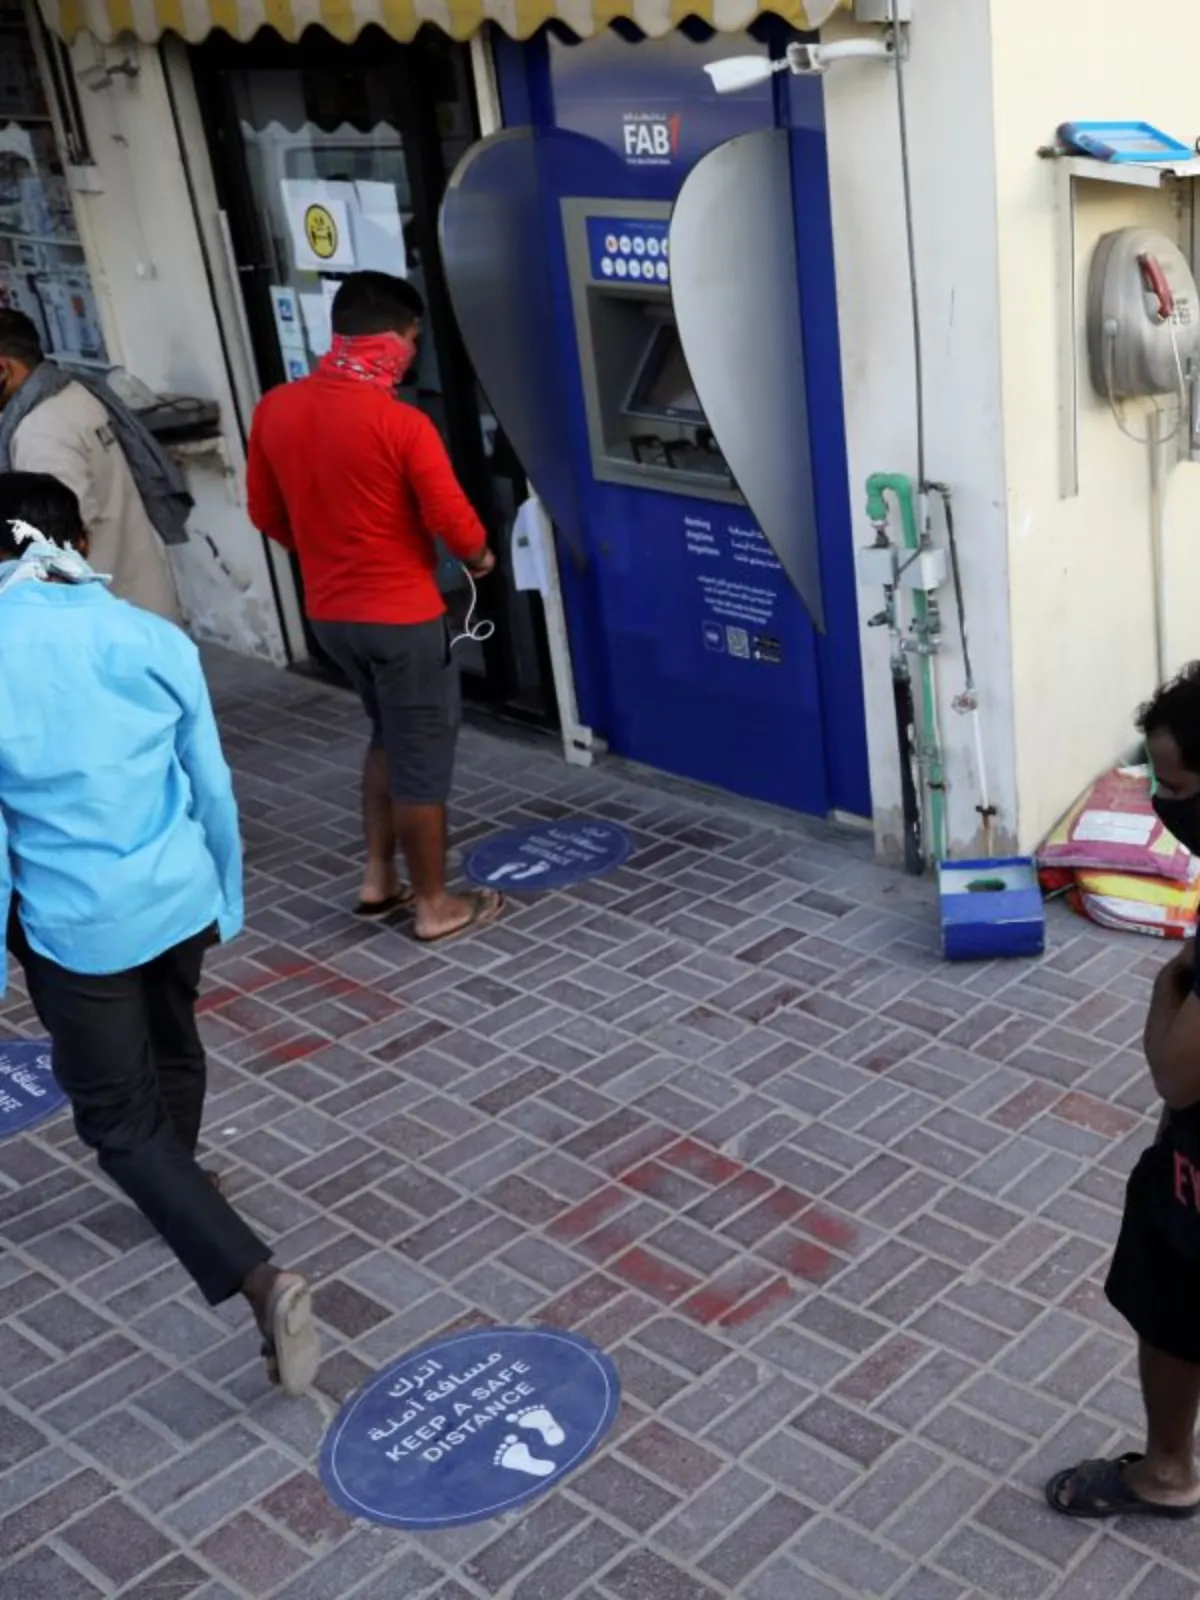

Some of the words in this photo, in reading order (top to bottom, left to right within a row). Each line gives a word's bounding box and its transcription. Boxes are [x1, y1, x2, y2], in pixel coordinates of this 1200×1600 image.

[623, 124, 671, 155] FAB
[389, 1359, 443, 1396] اترك
[424, 1353, 502, 1402] مسافة
[385, 1415, 447, 1462] KEEP
[453, 1402, 472, 1417] A
[471, 1360, 531, 1401] SAFE
[422, 1382, 535, 1462] DISTANCE
